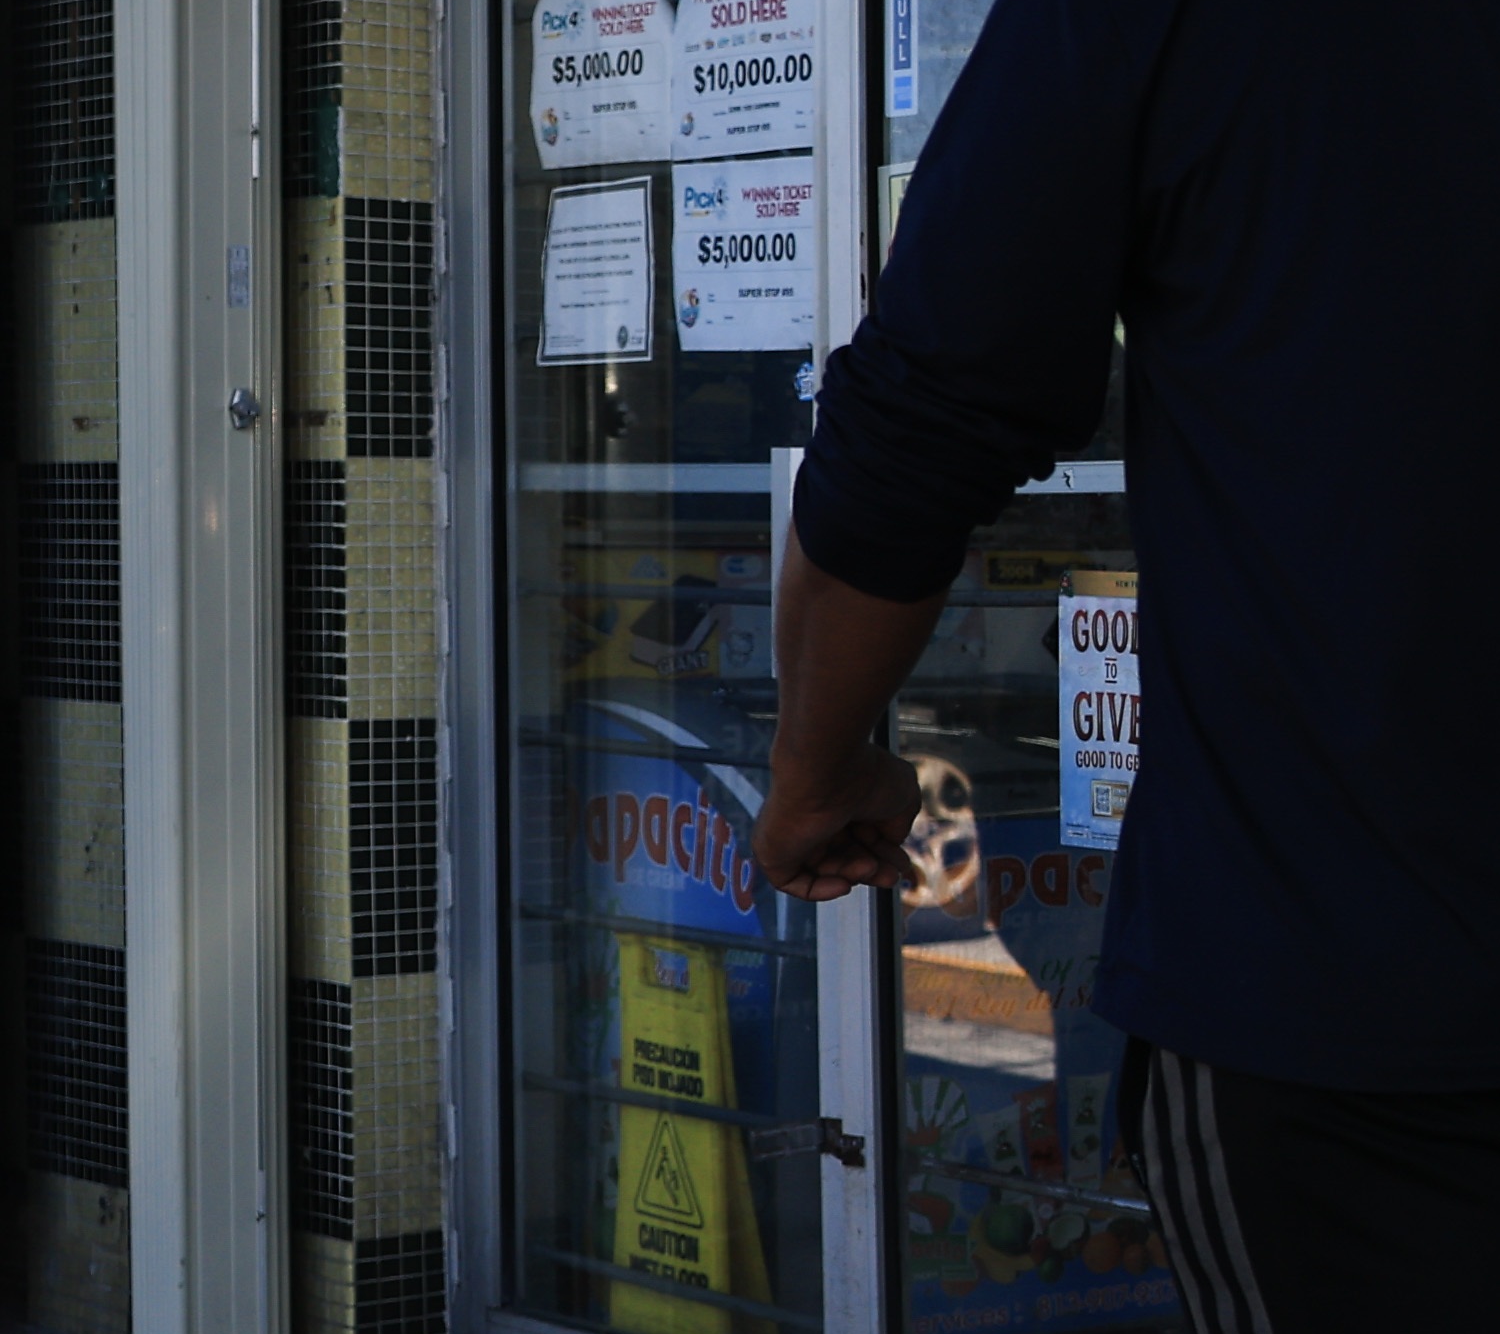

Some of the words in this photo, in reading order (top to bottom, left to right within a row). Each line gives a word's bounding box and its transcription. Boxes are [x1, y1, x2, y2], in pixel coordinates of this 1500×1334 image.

[568, 11, 578, 26] 4
[711, 2, 746, 28] SOLD
[553, 49, 643, 87] $5,000.00
[694, 53, 812, 95] $10,000.00
[684, 185, 714, 208] Pick
[714, 189, 724, 205] 4
[742, 186, 781, 201] WINNING
[783, 184, 812, 199] TICKET
[756, 203, 776, 218] SOLD
[777, 201, 800, 217] HERE
[698, 233, 796, 268] $5,000.00
[1105, 663, 1117, 679] TO
[1075, 750, 1105, 768] GOOD
[1110, 751, 1122, 769] TO
[567, 784, 755, 916] apacito
[634, 1037, 700, 1071] PRECAUCIÓN
[633, 1063, 655, 1087] PISO
[658, 1070, 704, 1098] MOJADO
[639, 1223, 699, 1263] CAUTION
